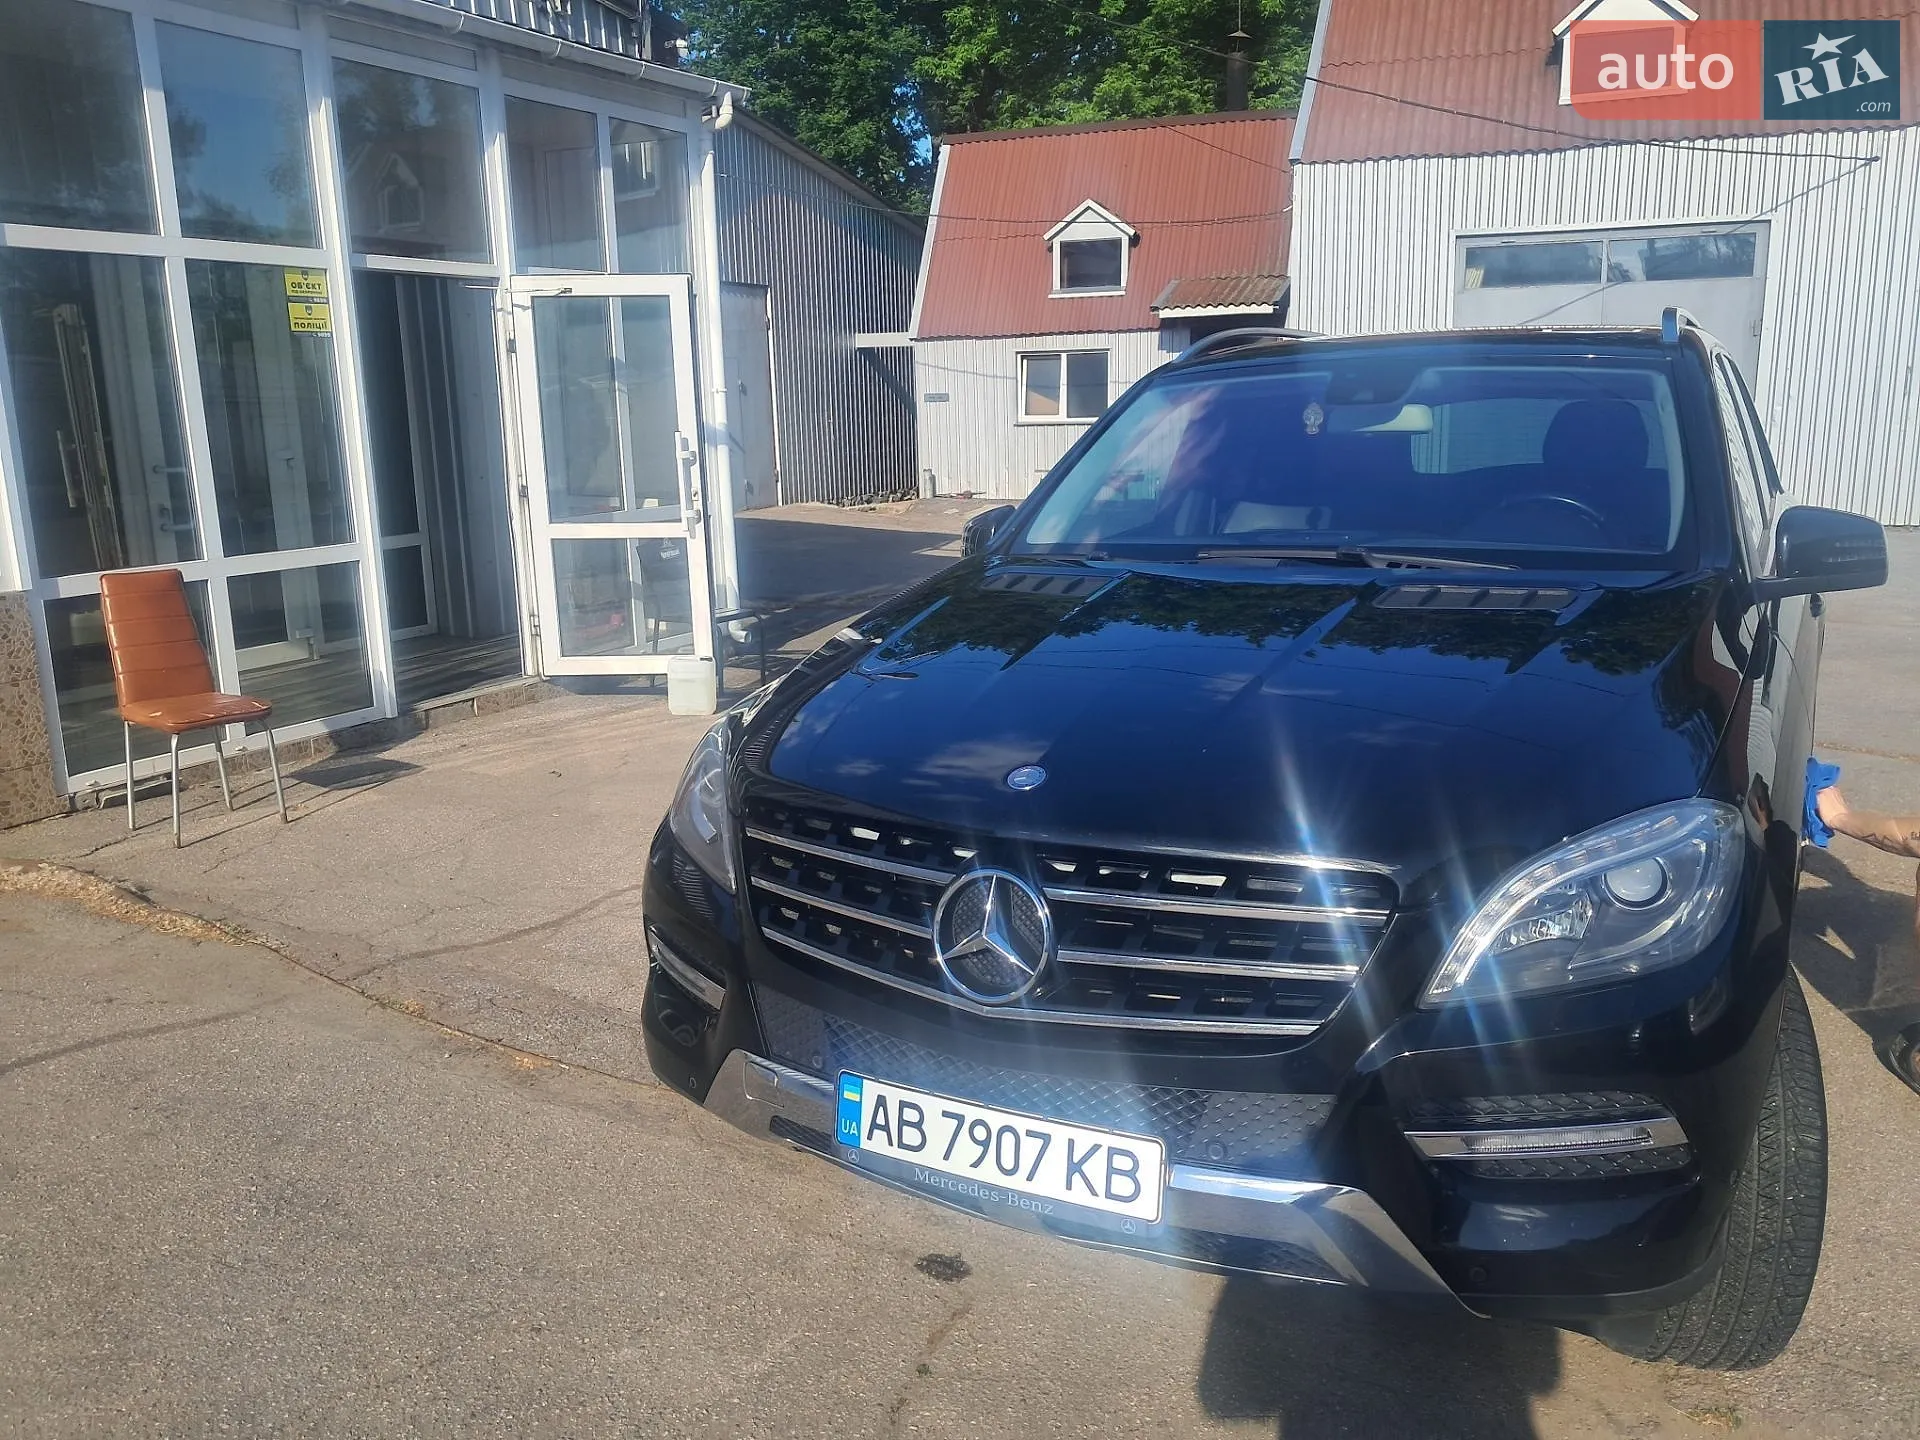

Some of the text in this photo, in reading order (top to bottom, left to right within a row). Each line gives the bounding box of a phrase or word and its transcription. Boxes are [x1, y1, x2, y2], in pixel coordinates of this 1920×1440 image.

[841, 1118, 859, 1136] UA
[867, 1094, 1141, 1204] AB 7907 KB
[914, 1167, 1054, 1215] Mercedes-Benz
